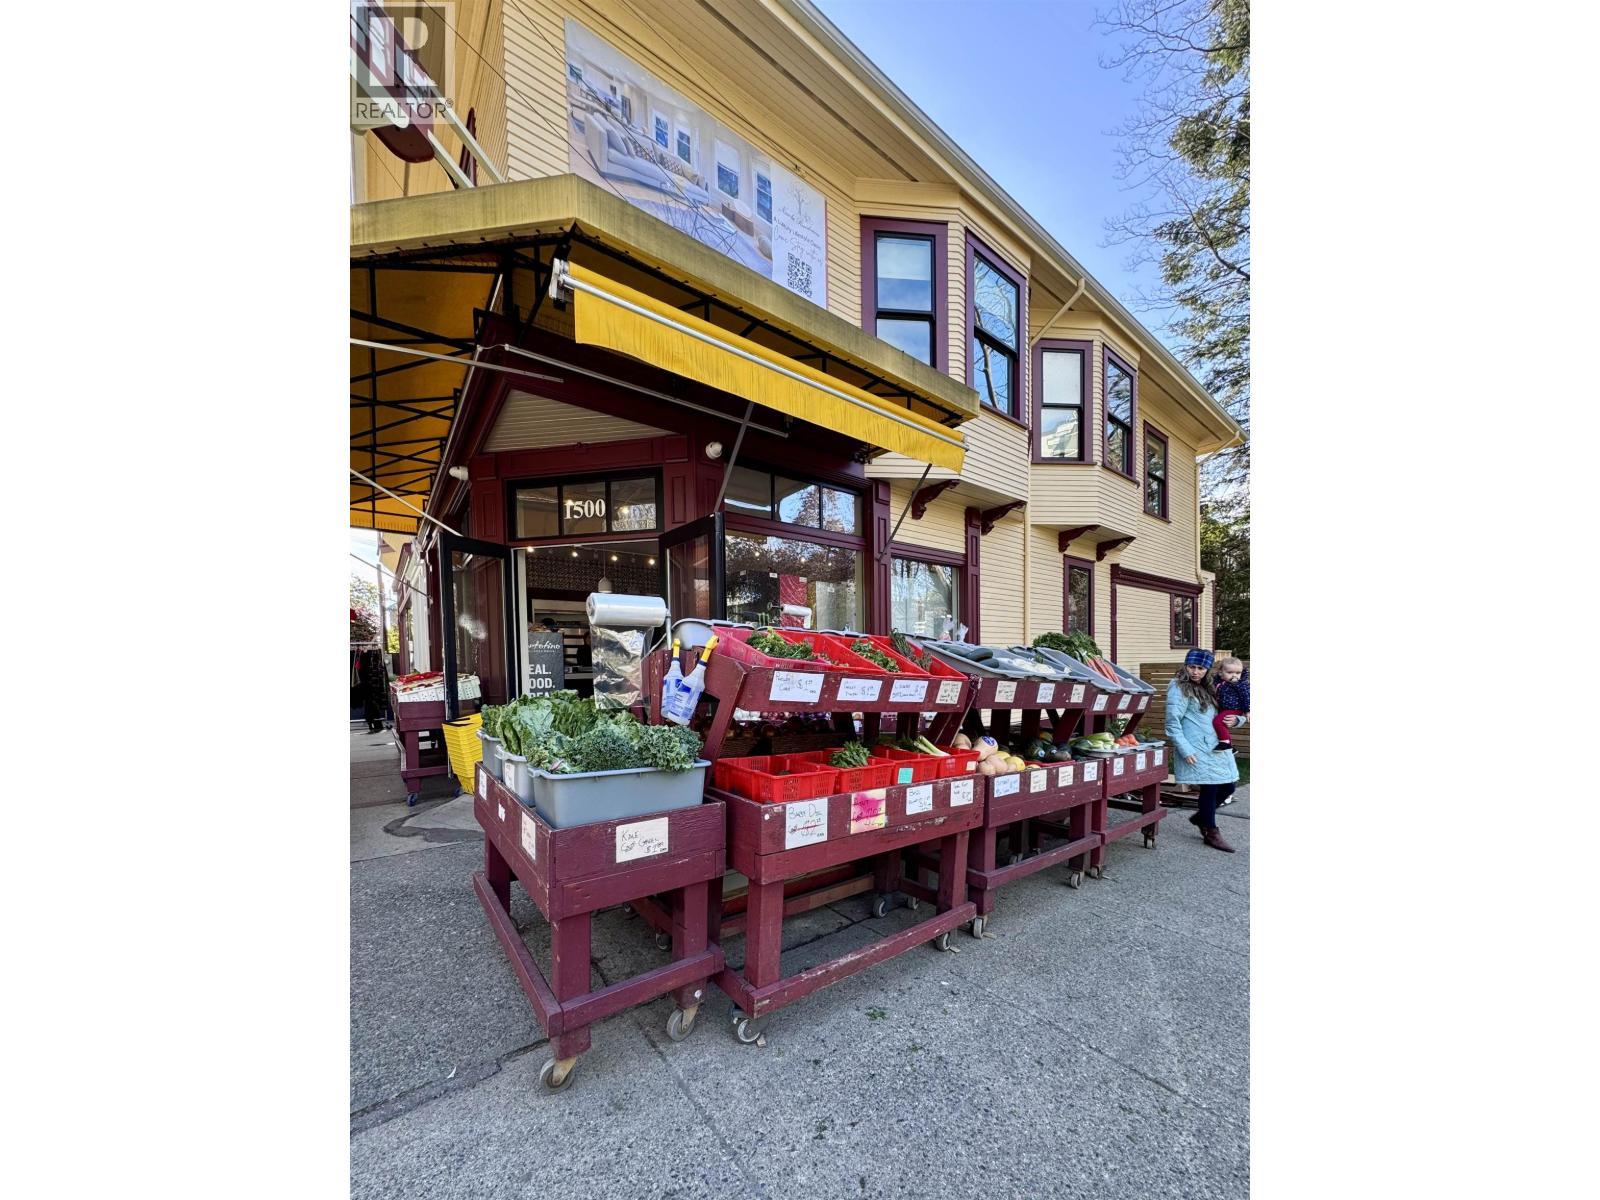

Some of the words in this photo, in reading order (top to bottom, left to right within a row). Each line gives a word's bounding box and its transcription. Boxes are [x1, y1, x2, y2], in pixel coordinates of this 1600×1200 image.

[564, 499, 606, 520] 1500
[529, 664, 552, 675] EAL.
[529, 678, 555, 689] OOD.
